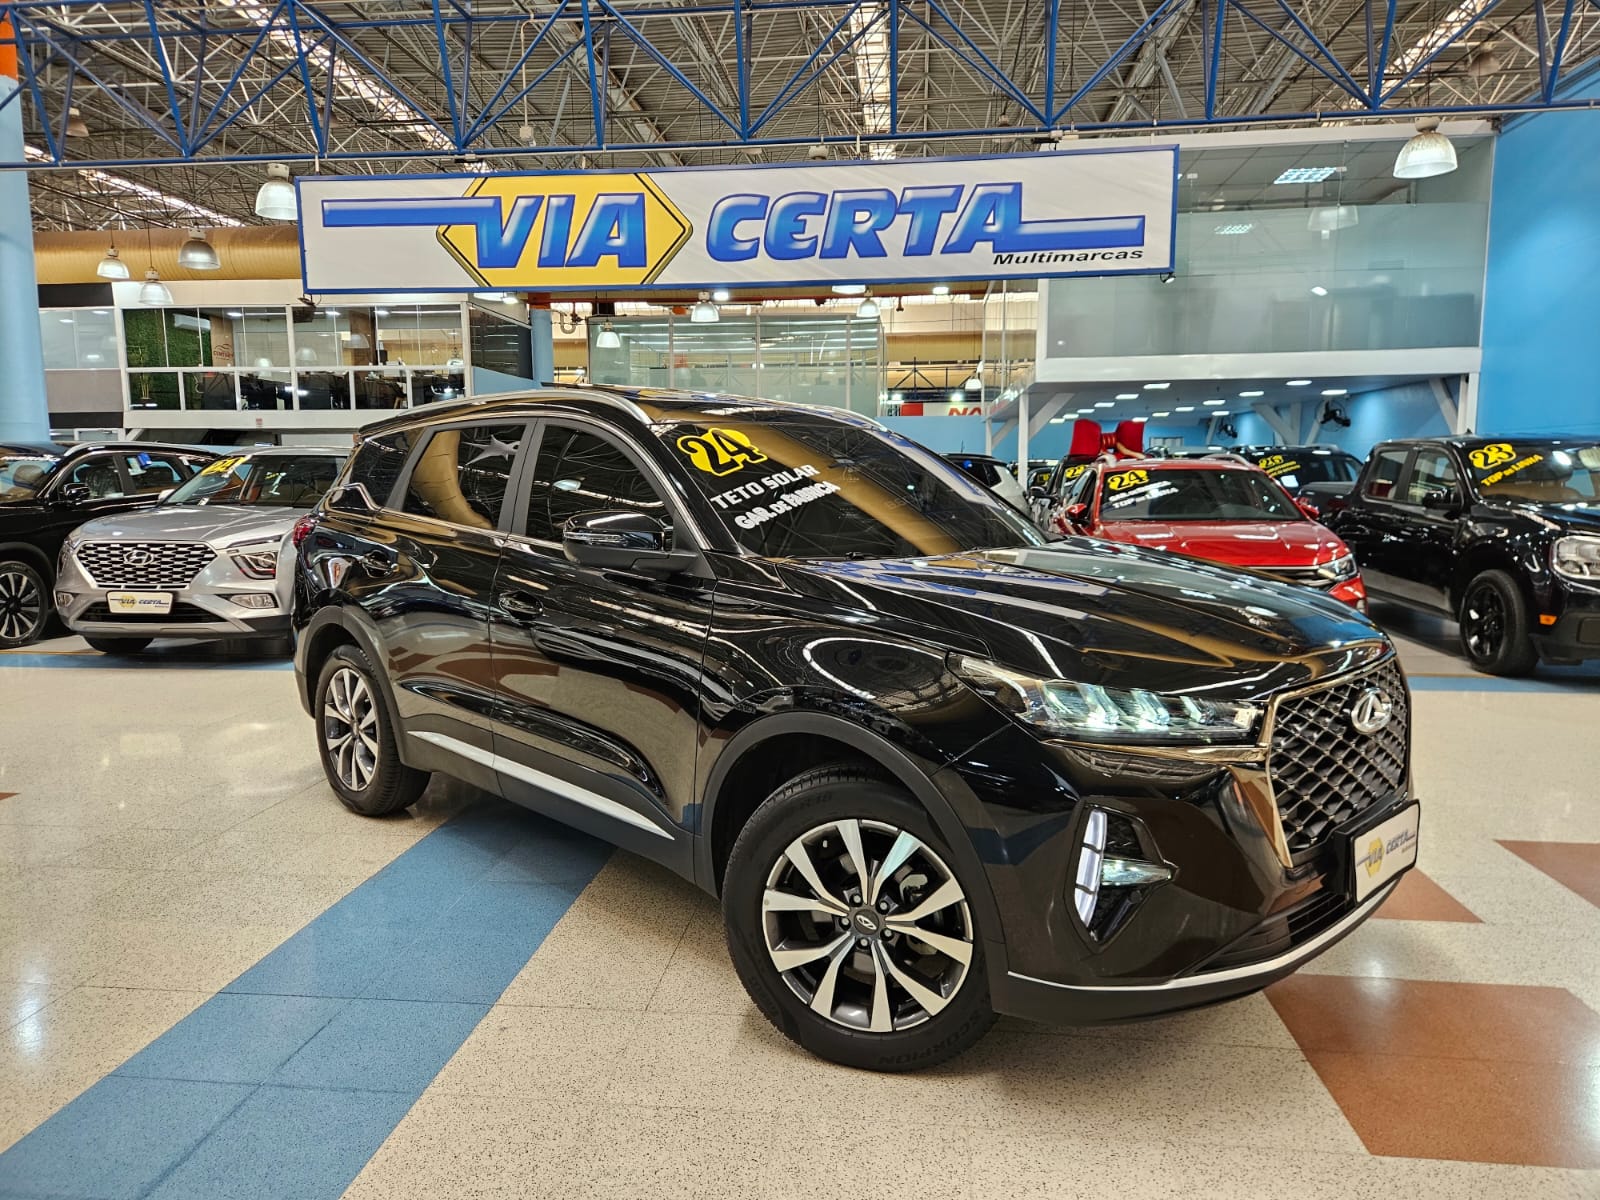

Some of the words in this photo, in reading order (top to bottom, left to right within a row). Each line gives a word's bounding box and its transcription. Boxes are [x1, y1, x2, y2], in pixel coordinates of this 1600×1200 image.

[466, 193, 647, 268] VIA
[706, 182, 1024, 262] CERTA
[993, 250, 1144, 265] Multimarcas
[677, 428, 768, 476] 24
[1469, 443, 1517, 470] 23
[710, 482, 765, 509] TETO
[761, 464, 821, 490] SOLAR
[1108, 470, 1149, 491] 24
[734, 506, 777, 529] GAR.
